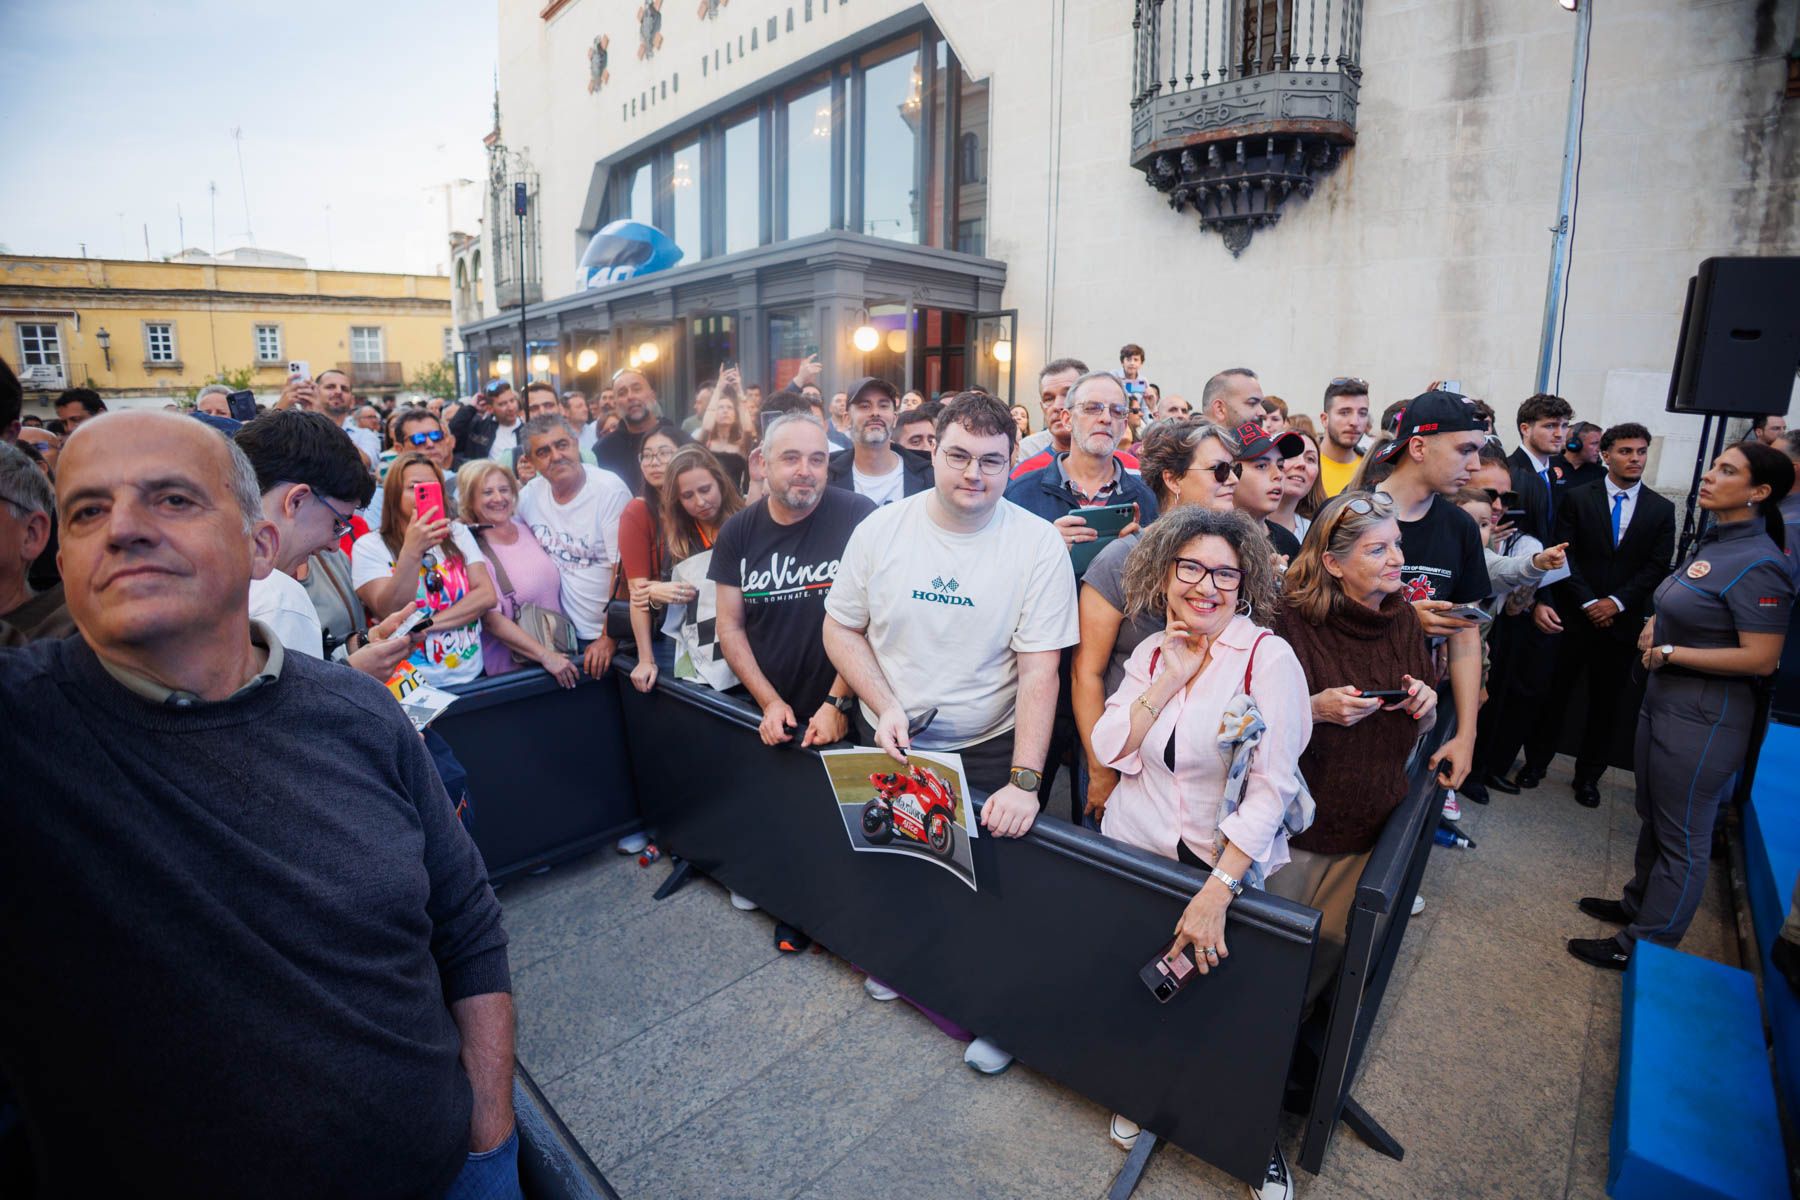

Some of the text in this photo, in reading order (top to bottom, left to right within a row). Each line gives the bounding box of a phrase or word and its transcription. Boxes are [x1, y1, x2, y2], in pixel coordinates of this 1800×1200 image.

[623, 0, 848, 122] TEATRO VILLAMAR
[911, 589, 975, 607] HONDA
